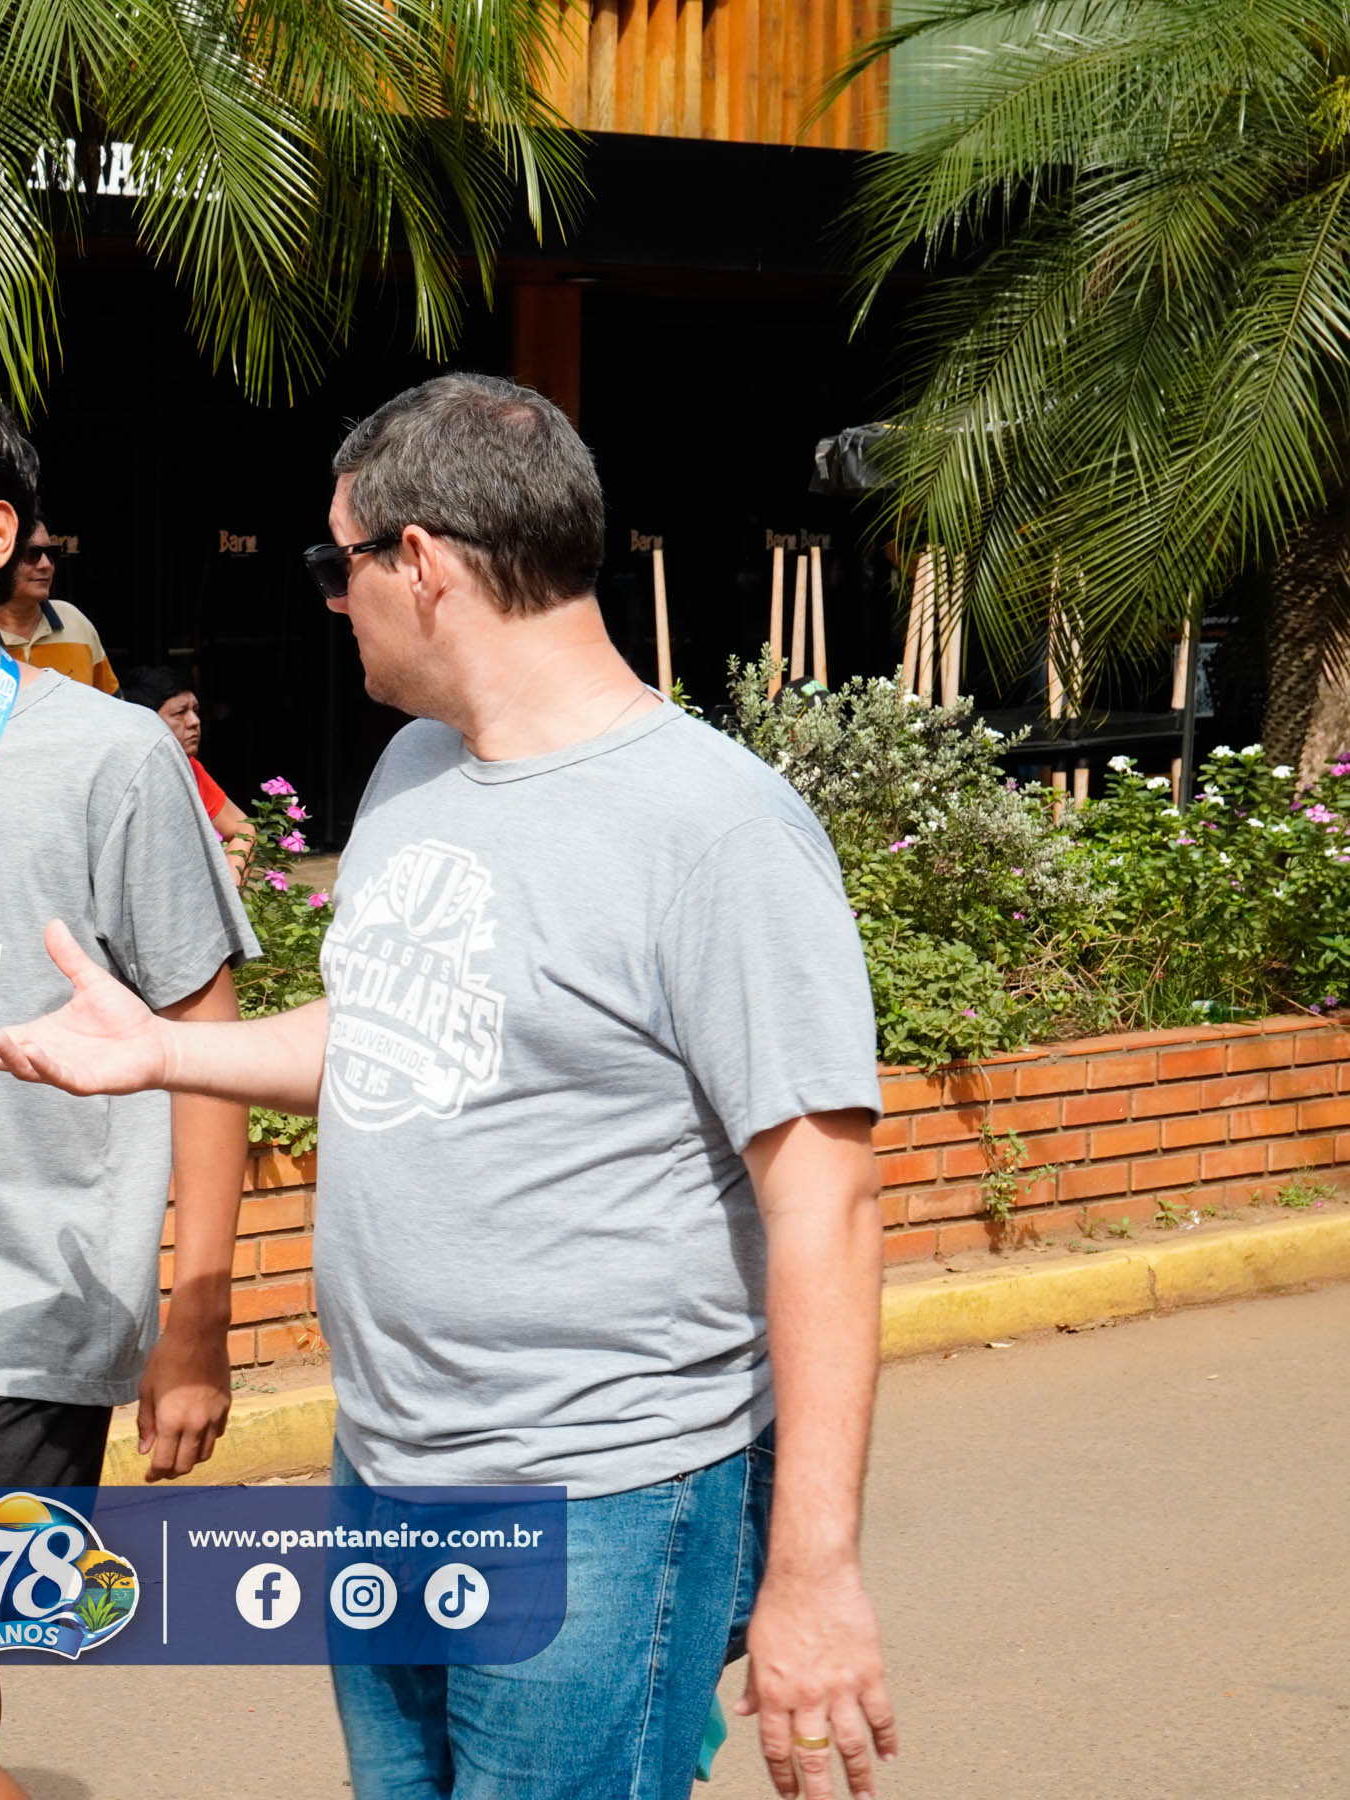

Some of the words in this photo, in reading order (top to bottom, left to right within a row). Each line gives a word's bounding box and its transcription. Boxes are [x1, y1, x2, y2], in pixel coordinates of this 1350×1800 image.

[358, 932, 451, 981] JOGOS
[351, 1026, 430, 1076] JUVENTUDE
[344, 1055, 367, 1090] DE
[363, 1063, 393, 1097] MS
